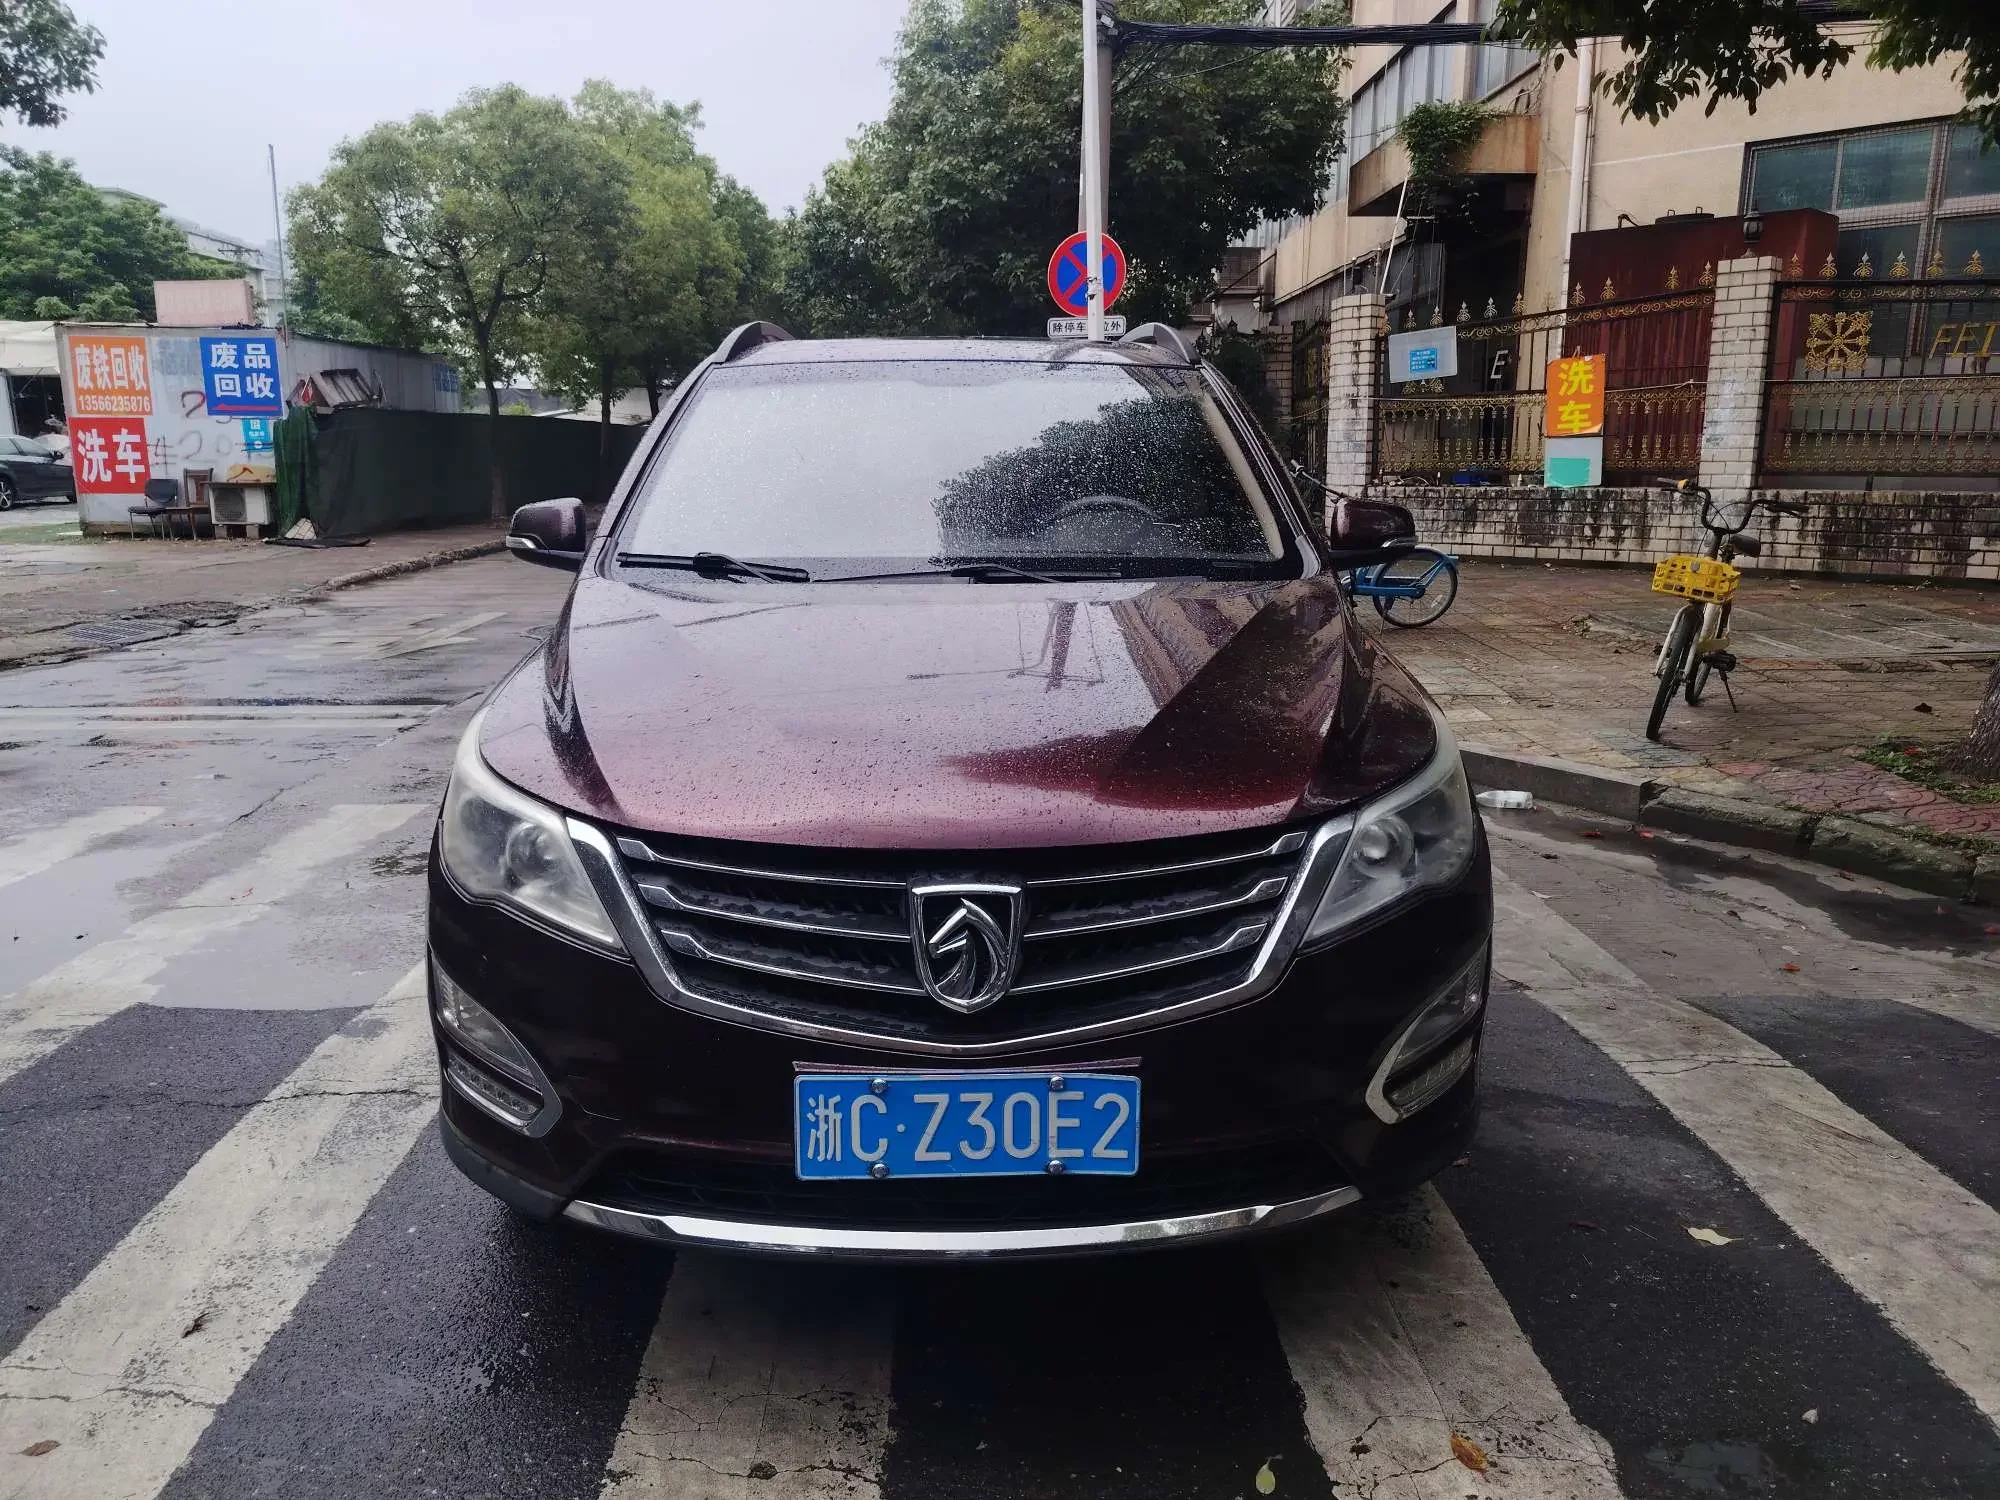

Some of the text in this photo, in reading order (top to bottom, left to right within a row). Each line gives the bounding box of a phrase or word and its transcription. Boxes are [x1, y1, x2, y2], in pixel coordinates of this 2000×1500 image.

[75, 344, 147, 391] 废铁回收
[210, 342, 272, 369] 废品
[78, 394, 151, 412] 13566235876
[214, 373, 276, 399] 回收
[1556, 360, 1595, 434] 洗车
[77, 428, 146, 484] 洗车
[807, 1091, 1131, 1162] 浙C·Z30E2
